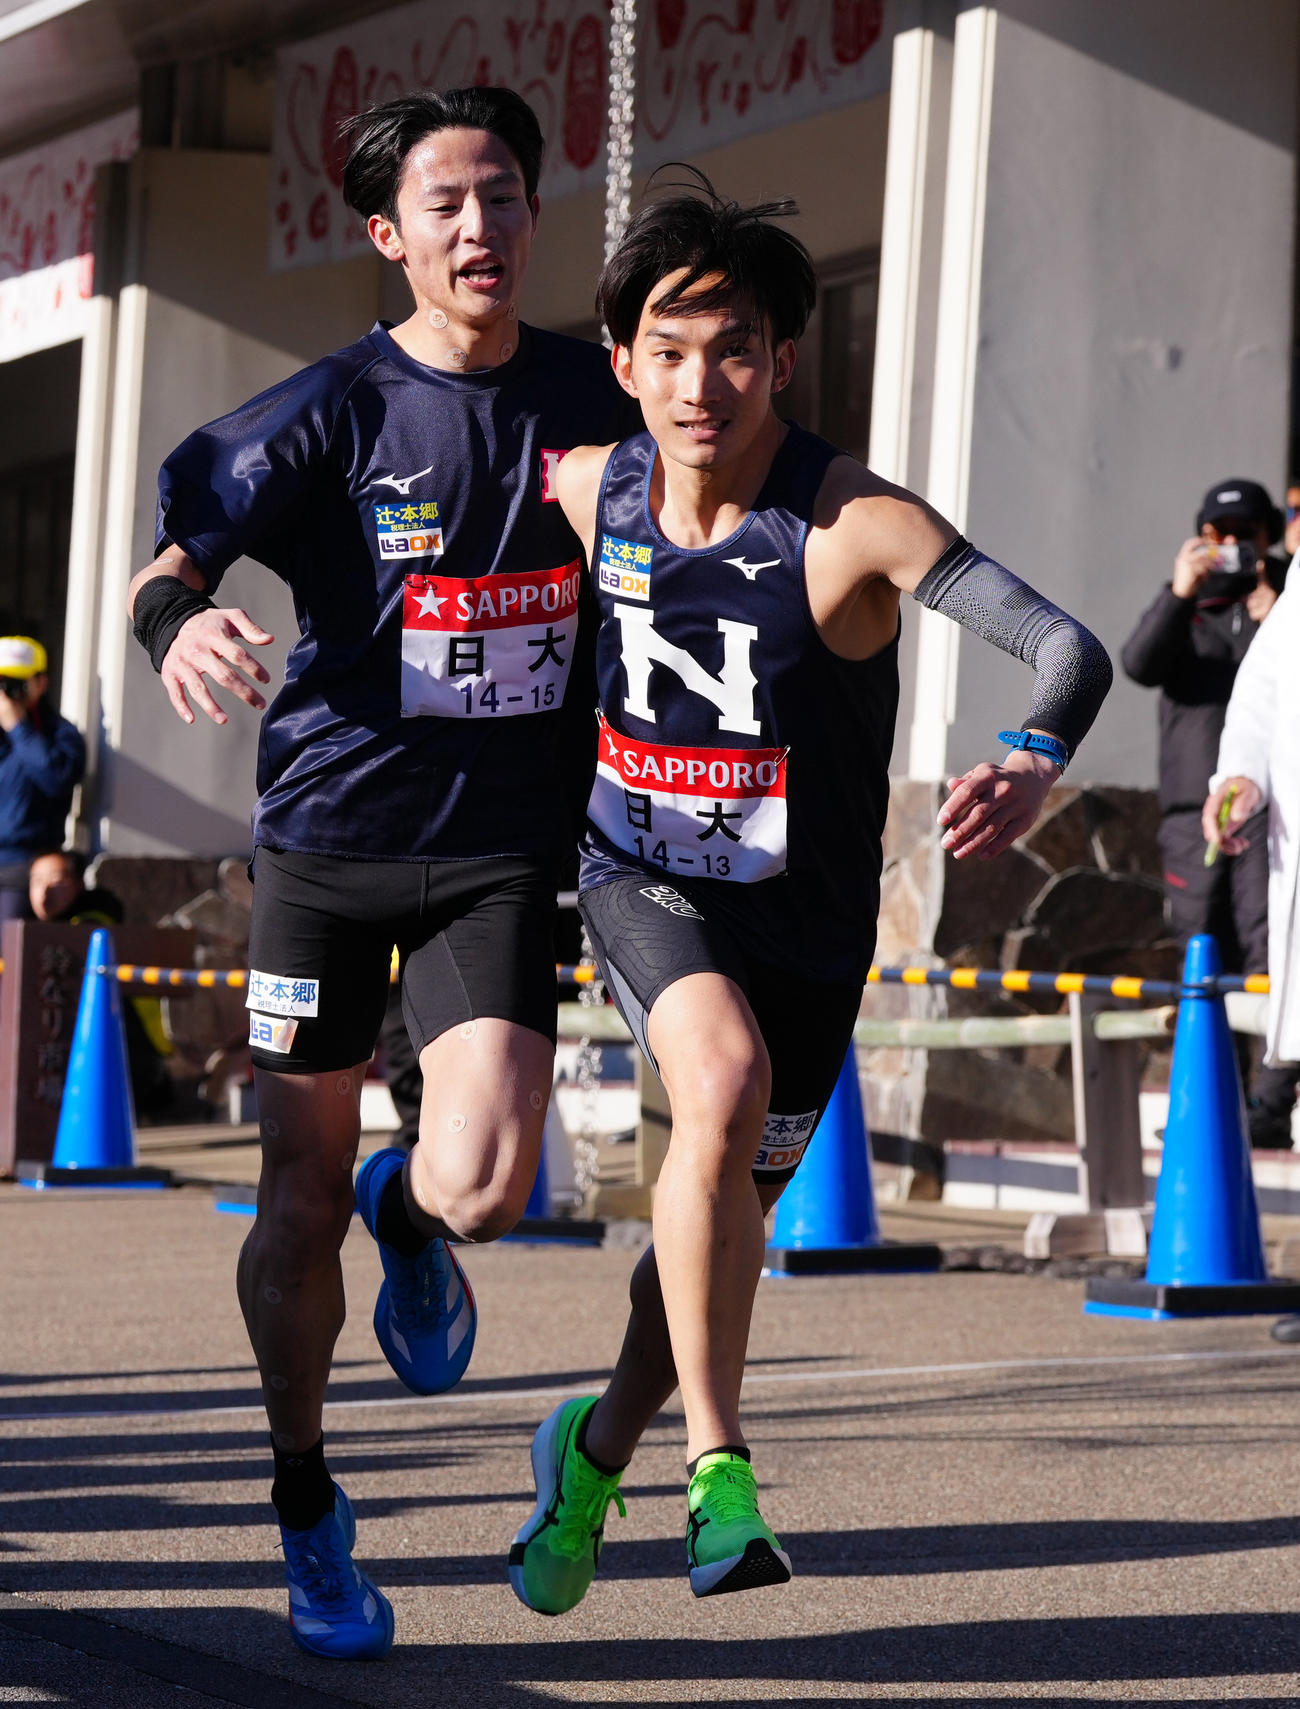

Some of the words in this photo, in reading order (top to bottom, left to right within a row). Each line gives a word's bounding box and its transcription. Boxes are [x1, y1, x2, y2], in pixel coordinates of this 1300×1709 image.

[456, 571, 580, 621] SAPPORO
[613, 602, 761, 736] N
[623, 750, 778, 788] SAPPORO
